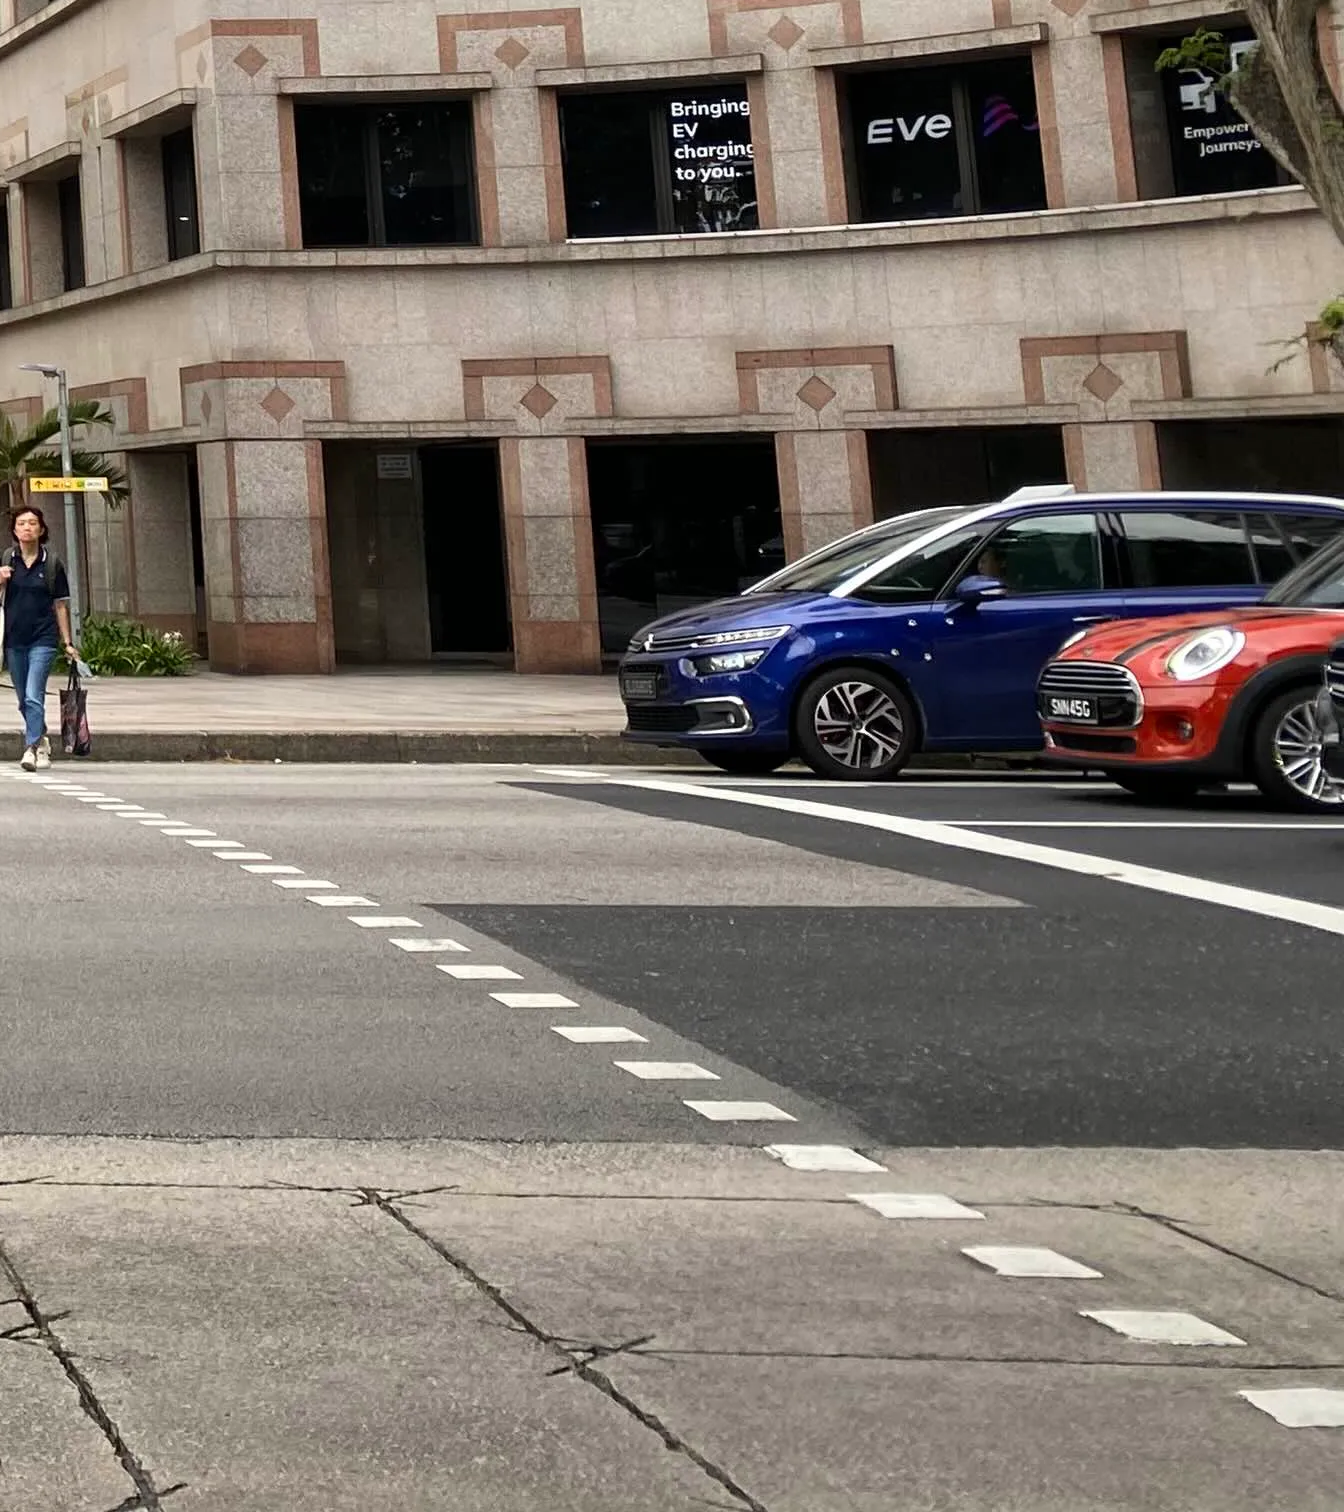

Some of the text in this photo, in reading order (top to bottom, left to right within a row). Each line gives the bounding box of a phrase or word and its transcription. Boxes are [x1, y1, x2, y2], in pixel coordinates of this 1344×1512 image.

[671, 99, 750, 118] Bringing
[673, 122, 698, 138] EV
[674, 140, 754, 160] charging
[1200, 139, 1261, 157] Journeys
[675, 166, 741, 183] to you.
